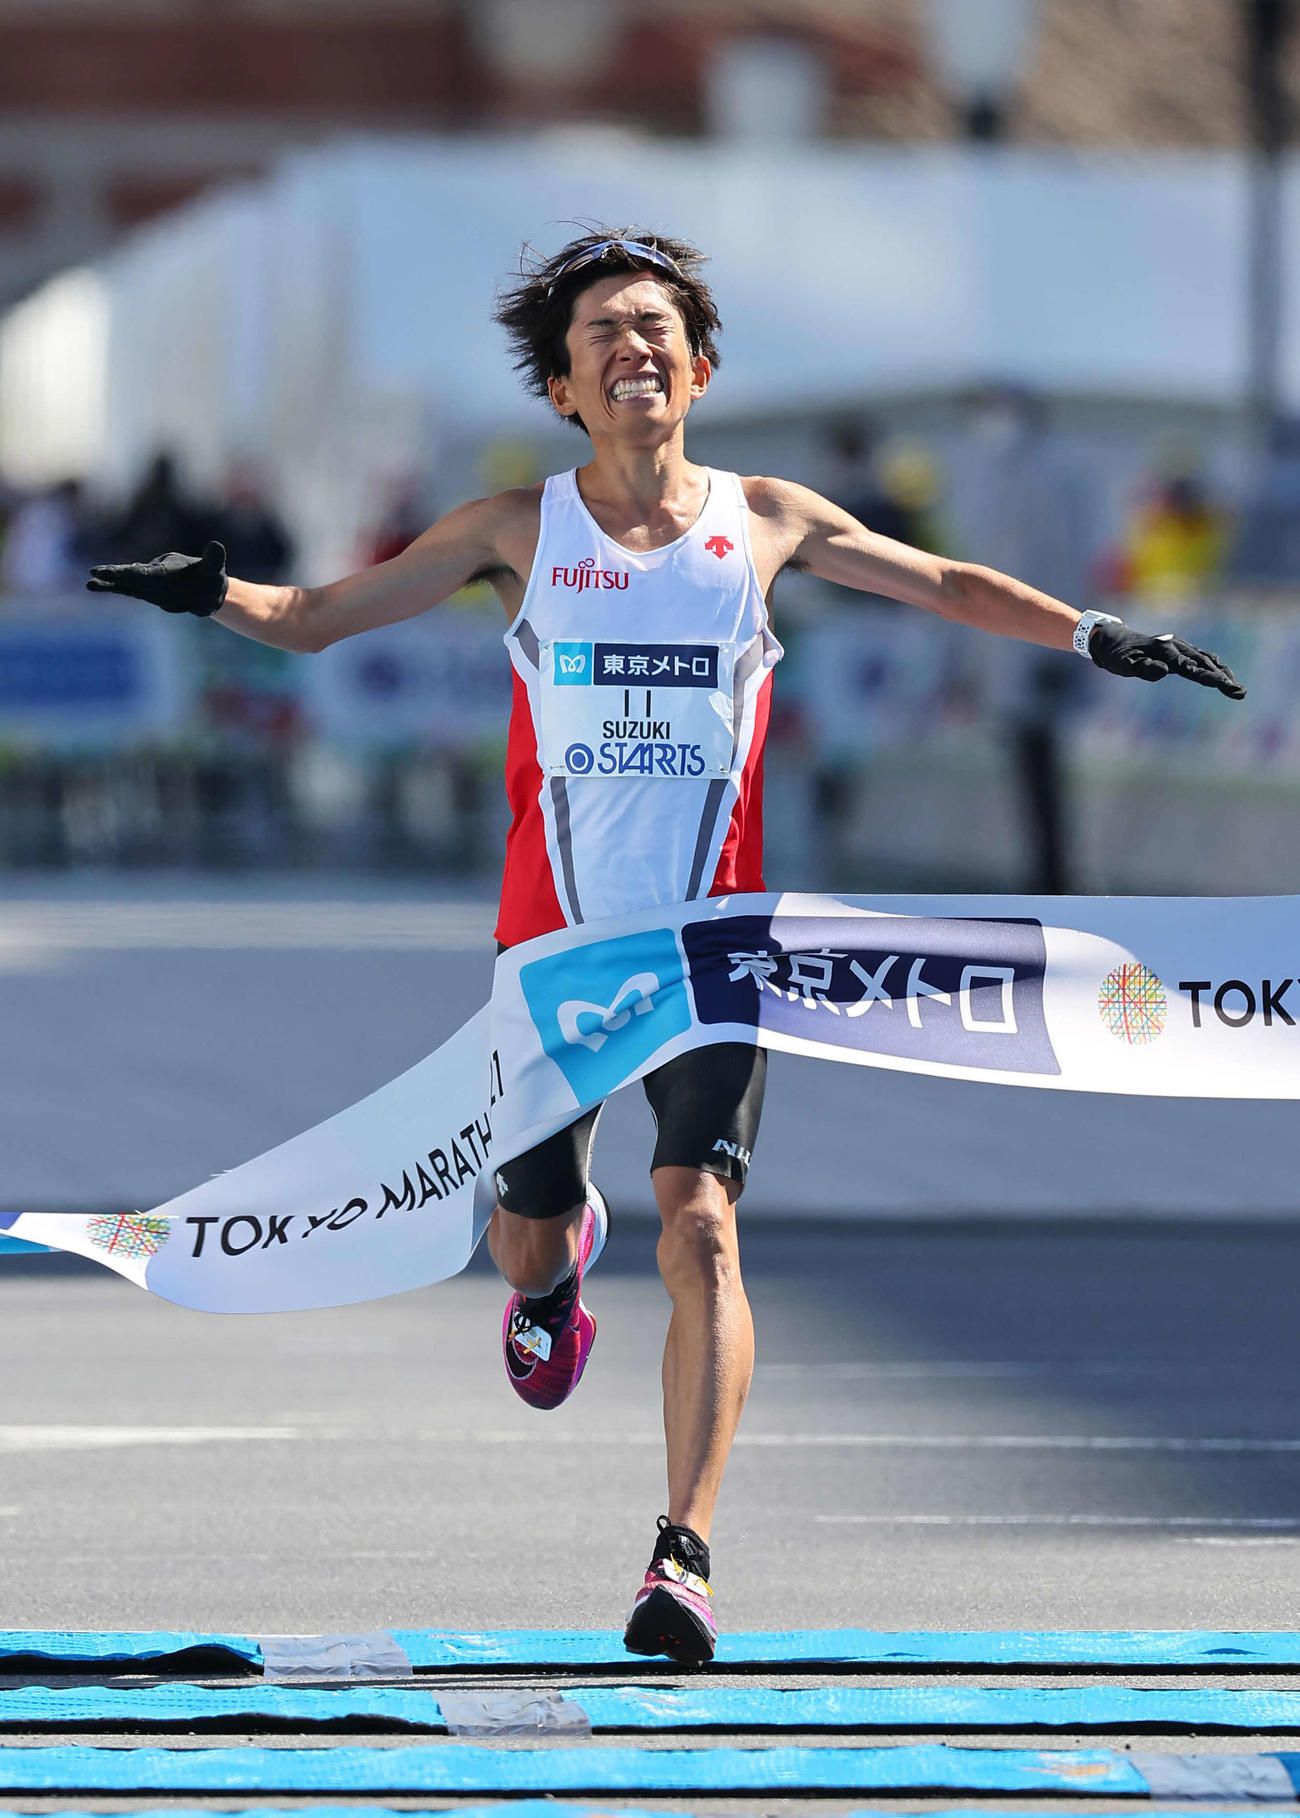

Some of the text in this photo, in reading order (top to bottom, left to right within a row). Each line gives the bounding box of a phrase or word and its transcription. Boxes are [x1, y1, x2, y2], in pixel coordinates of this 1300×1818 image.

[552, 558, 629, 593] FUJITSU
[602, 654, 710, 677] 東京メトロ
[624, 689, 651, 717] 11
[602, 721, 671, 740] SUZUKI
[597, 742, 706, 776] STARTS
[728, 949, 1018, 1034] 東京メトロ
[1178, 978, 1300, 1028] TOK
[186, 1197, 368, 1258] TOKYO
[375, 1112, 493, 1220] MARATH
